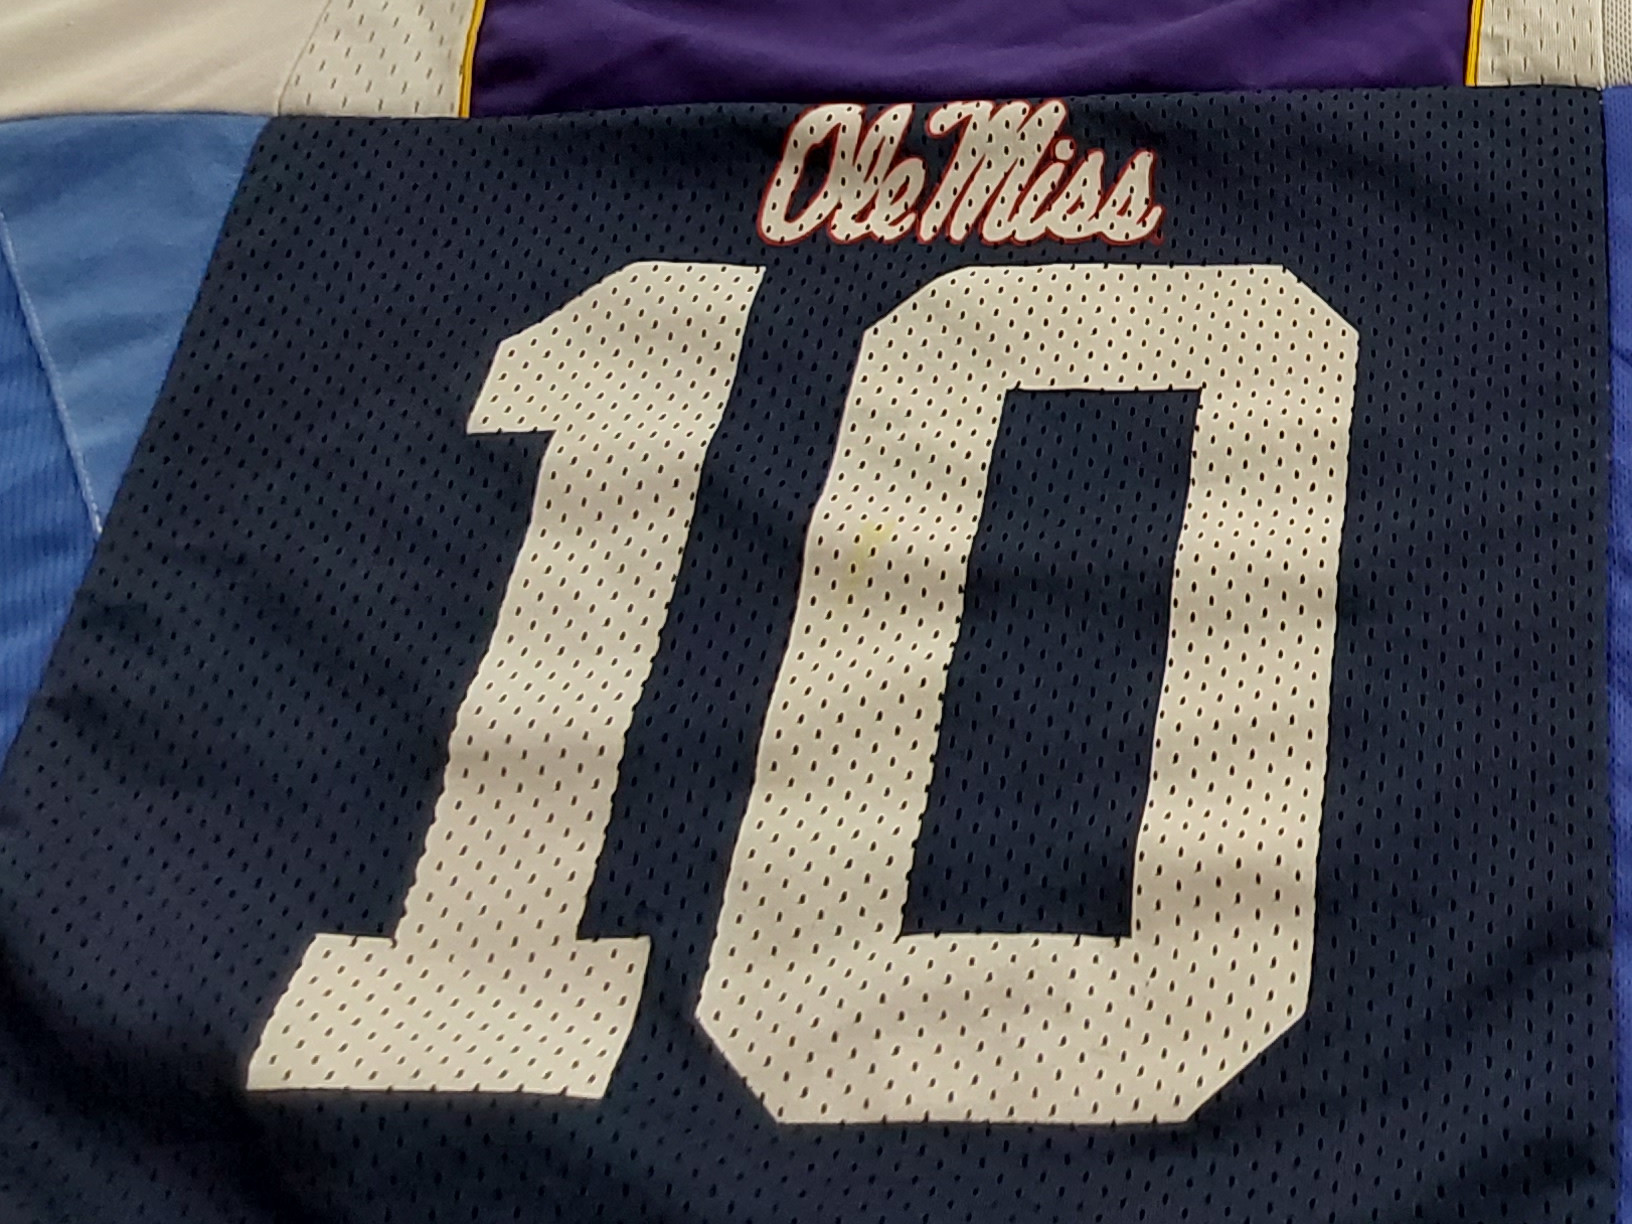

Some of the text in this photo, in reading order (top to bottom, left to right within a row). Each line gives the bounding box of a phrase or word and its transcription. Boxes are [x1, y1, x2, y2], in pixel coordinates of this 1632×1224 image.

[757, 99, 1165, 245] Ole Miss
[247, 261, 1359, 1125] 10
